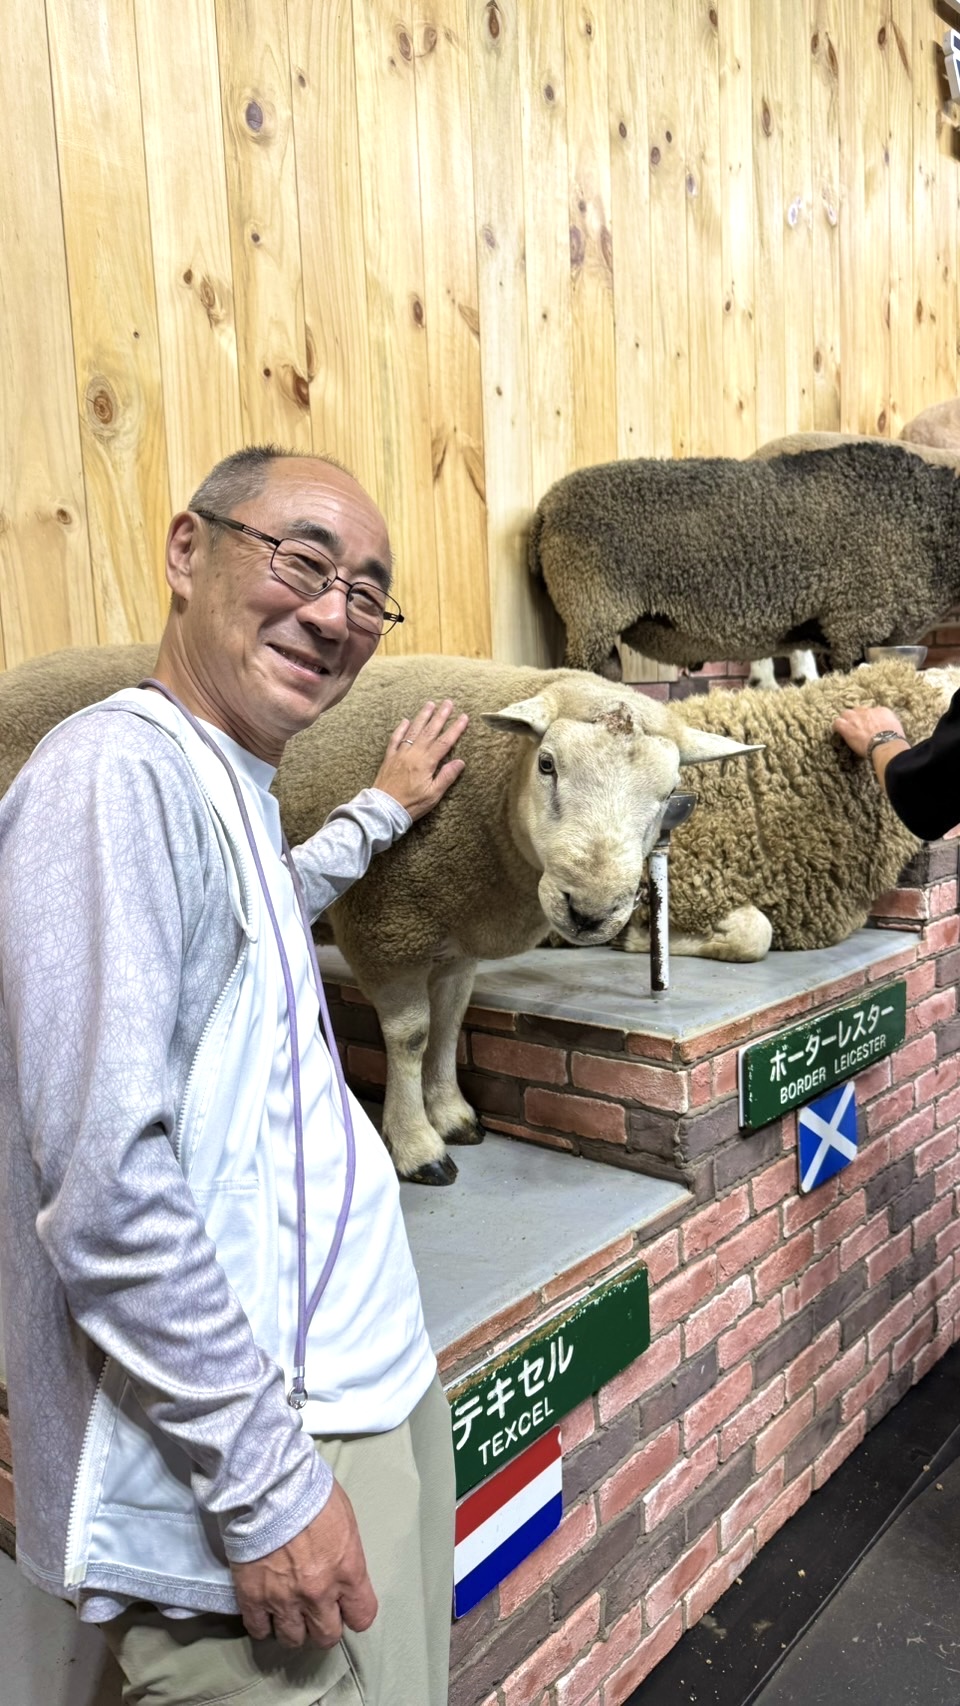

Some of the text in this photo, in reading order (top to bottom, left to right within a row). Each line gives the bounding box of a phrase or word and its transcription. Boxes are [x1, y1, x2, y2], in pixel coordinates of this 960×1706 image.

[770, 1004, 894, 1082] ボーダーレスター
[780, 1034, 887, 1104] BORDER LEICESTER
[453, 1336, 574, 1450] テキセル
[478, 1397, 554, 1465] TEXCEL
